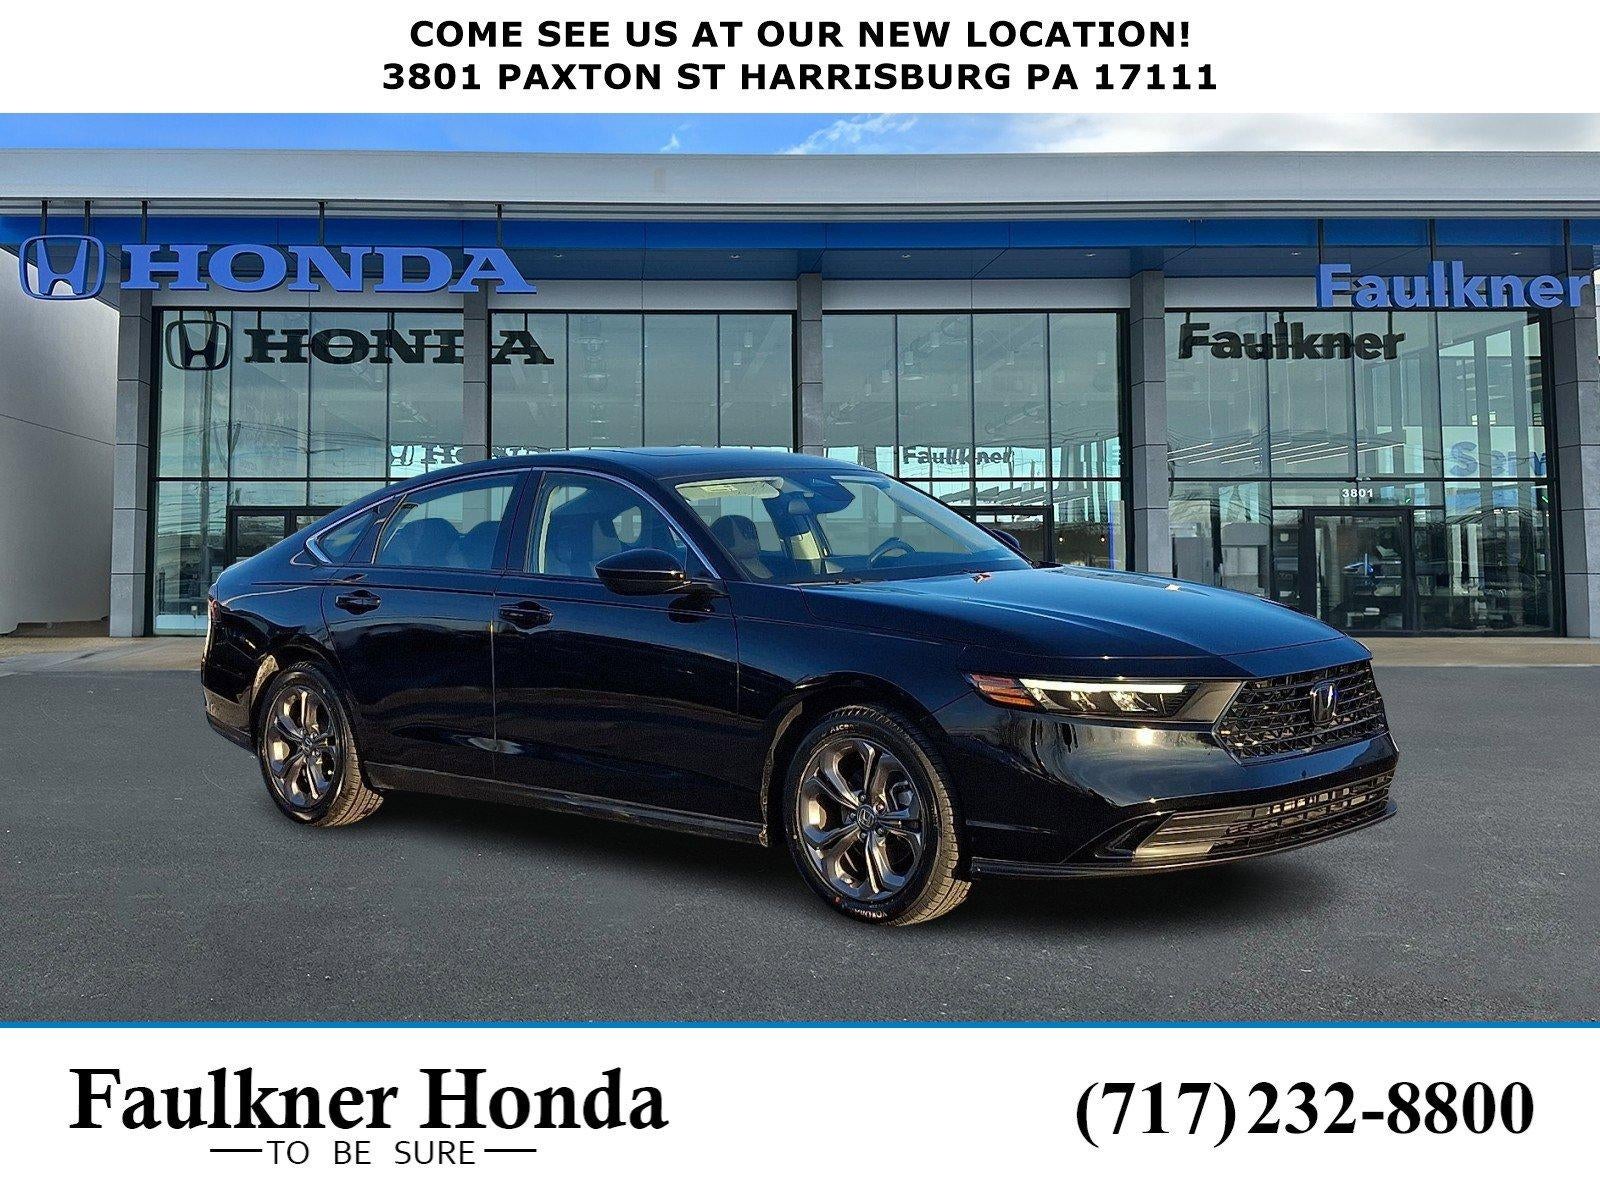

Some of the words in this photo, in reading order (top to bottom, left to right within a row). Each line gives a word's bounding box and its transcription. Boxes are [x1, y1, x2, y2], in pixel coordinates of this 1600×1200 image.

[121, 243, 537, 295] HONDA
[1315, 260, 1591, 310] Faulkner
[1178, 322, 1406, 360] Faulkner
[1341, 488, 1374, 498] 3801
